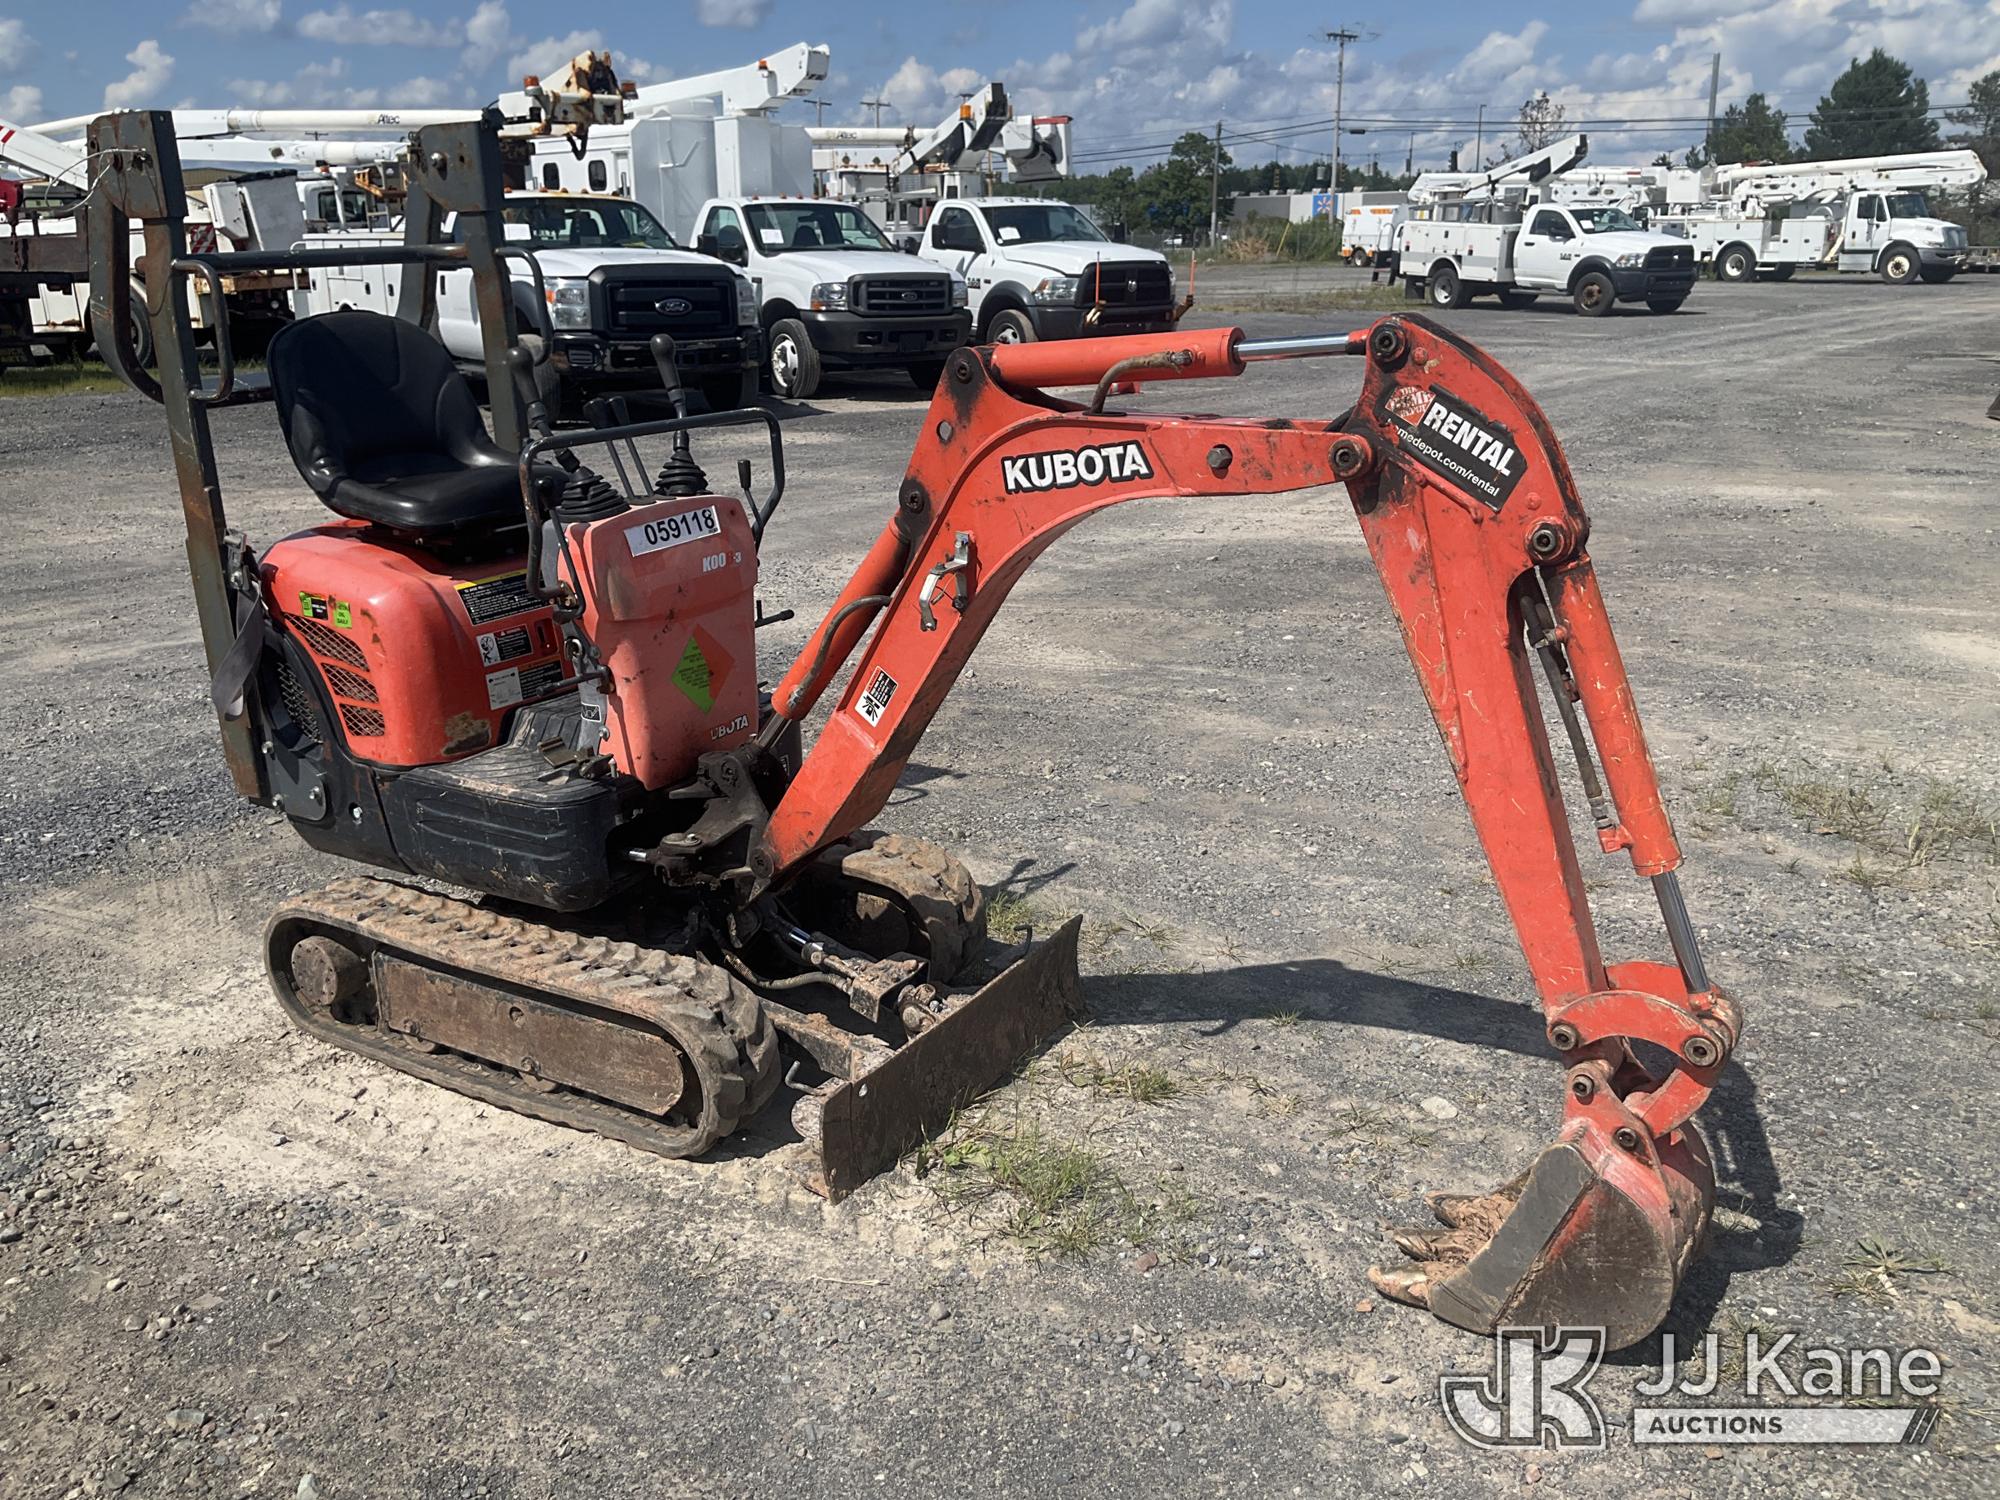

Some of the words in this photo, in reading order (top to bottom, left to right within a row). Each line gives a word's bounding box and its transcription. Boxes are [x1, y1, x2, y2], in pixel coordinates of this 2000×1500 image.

[377, 113, 400, 124] Altec
[1386, 418, 1500, 497] medepot.com/rental
[1423, 402, 1515, 477] RENTAL
[1004, 444, 1149, 490] KUBOTA
[644, 509, 714, 545] 059118
